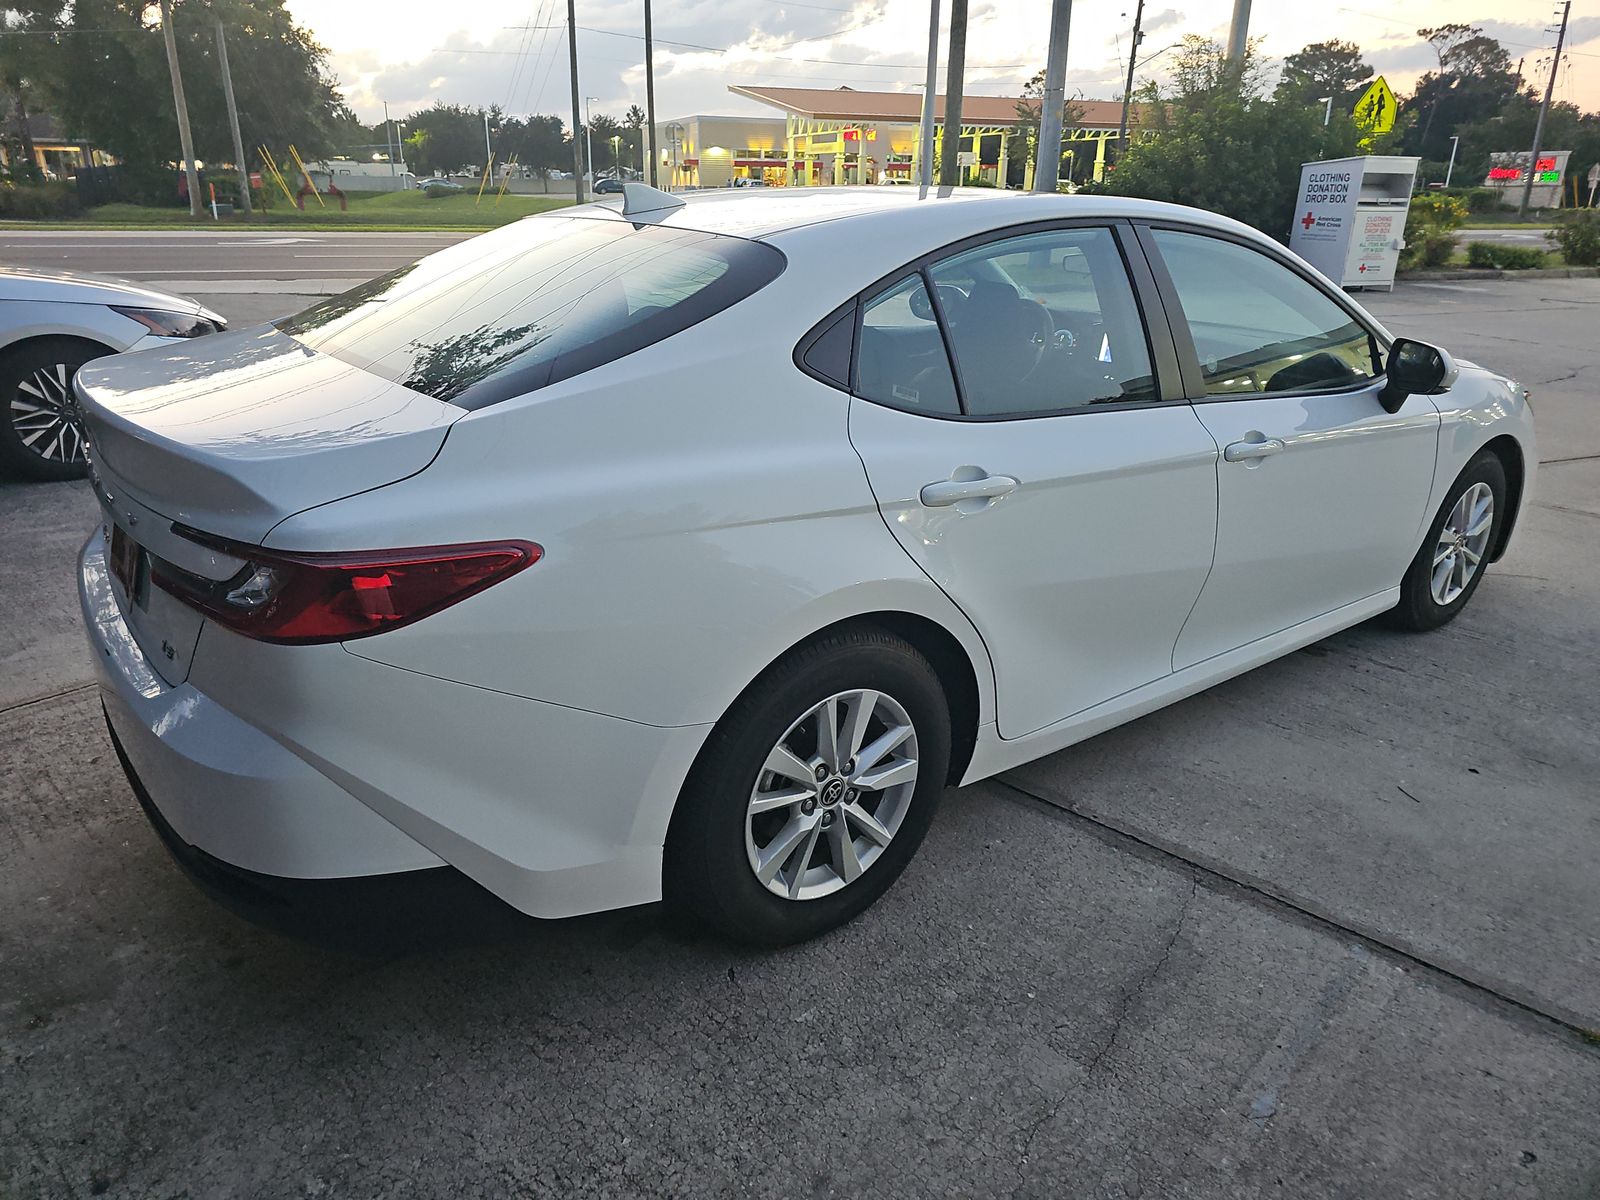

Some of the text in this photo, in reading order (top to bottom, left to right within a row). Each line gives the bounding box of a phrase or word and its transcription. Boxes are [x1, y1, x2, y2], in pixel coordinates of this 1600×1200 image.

[1309, 173, 1351, 182] CLOTHING
[1307, 184, 1349, 193] DONATION
[1305, 194, 1347, 203] DROP BOX
